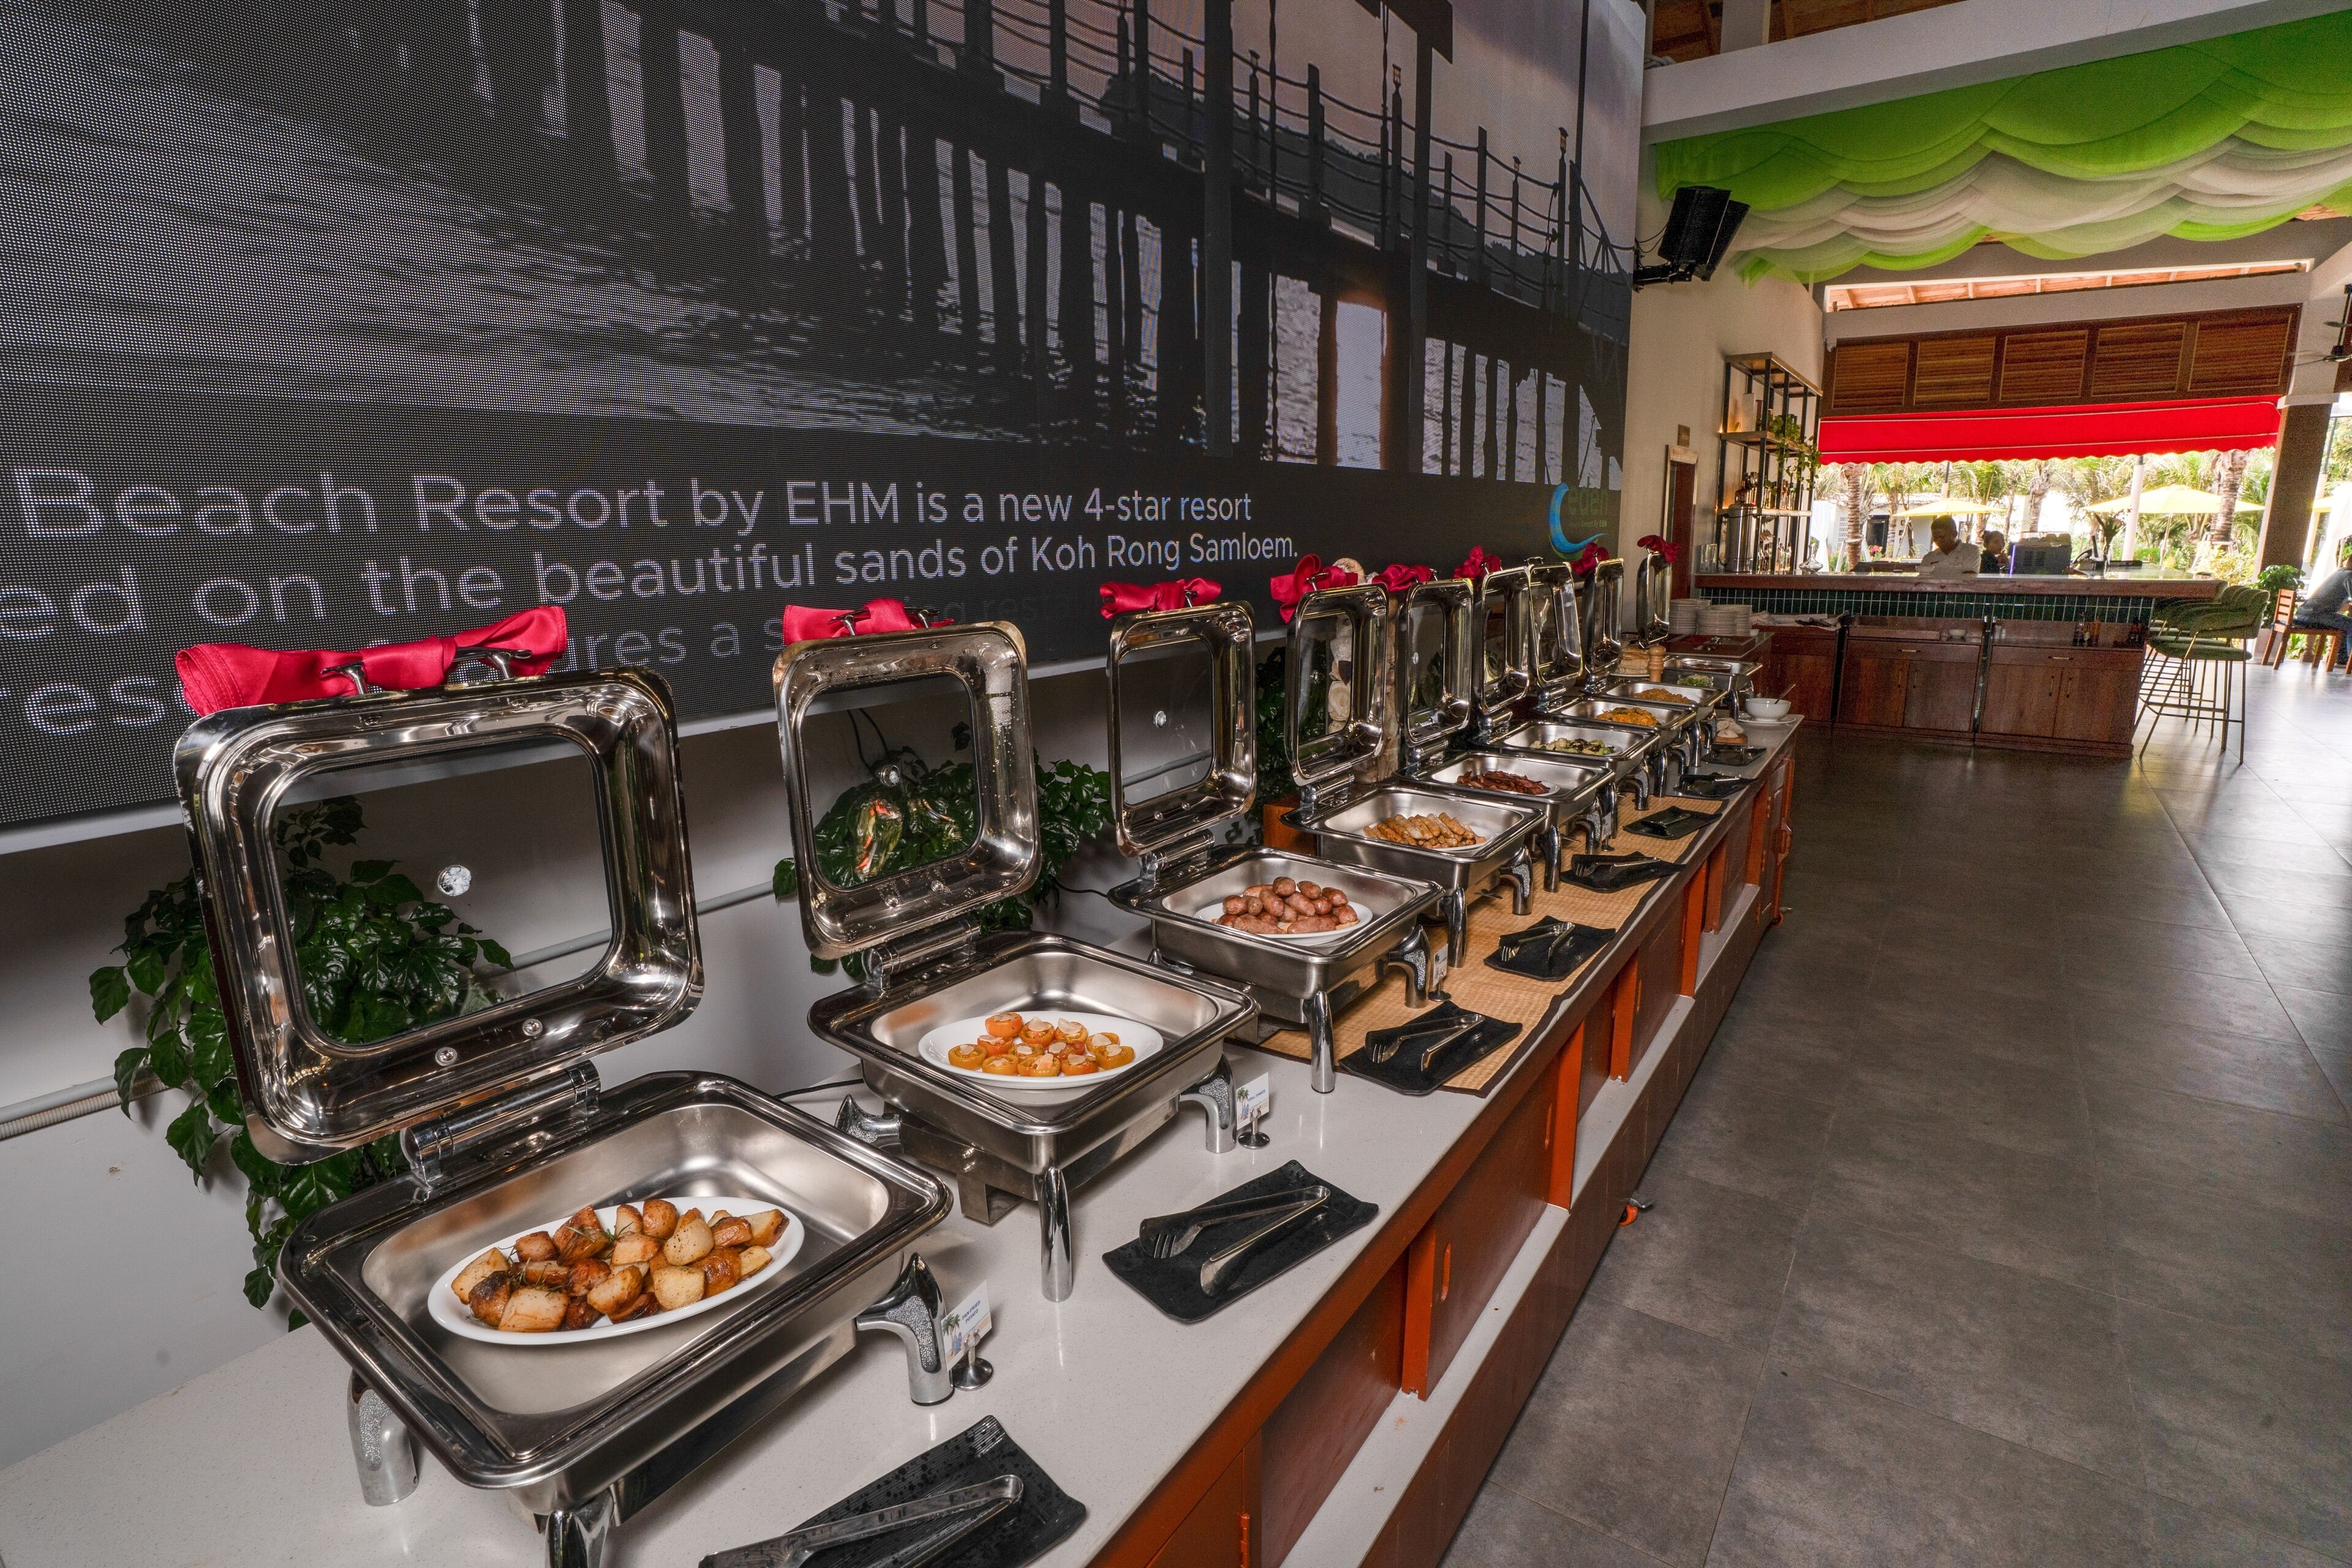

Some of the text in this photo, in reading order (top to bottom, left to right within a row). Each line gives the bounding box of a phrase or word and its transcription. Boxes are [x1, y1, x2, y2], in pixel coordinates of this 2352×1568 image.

[15, 467, 1251, 538] Beach Resort by EHM is a new 4-star resort
[192, 576, 327, 627] on
[361, 556, 504, 616] the
[533, 543, 815, 603] beautiful
[835, 538, 967, 584] sands
[980, 536, 1017, 575] of
[1031, 535, 1096, 571] Koh
[1107, 534, 1180, 571] Rong
[1189, 532, 1298, 563] Samloem.
[710, 622, 741, 658] a
[962, 1300, 981, 1320] PAN-FRIED
[965, 1308, 979, 1324] POTATO
